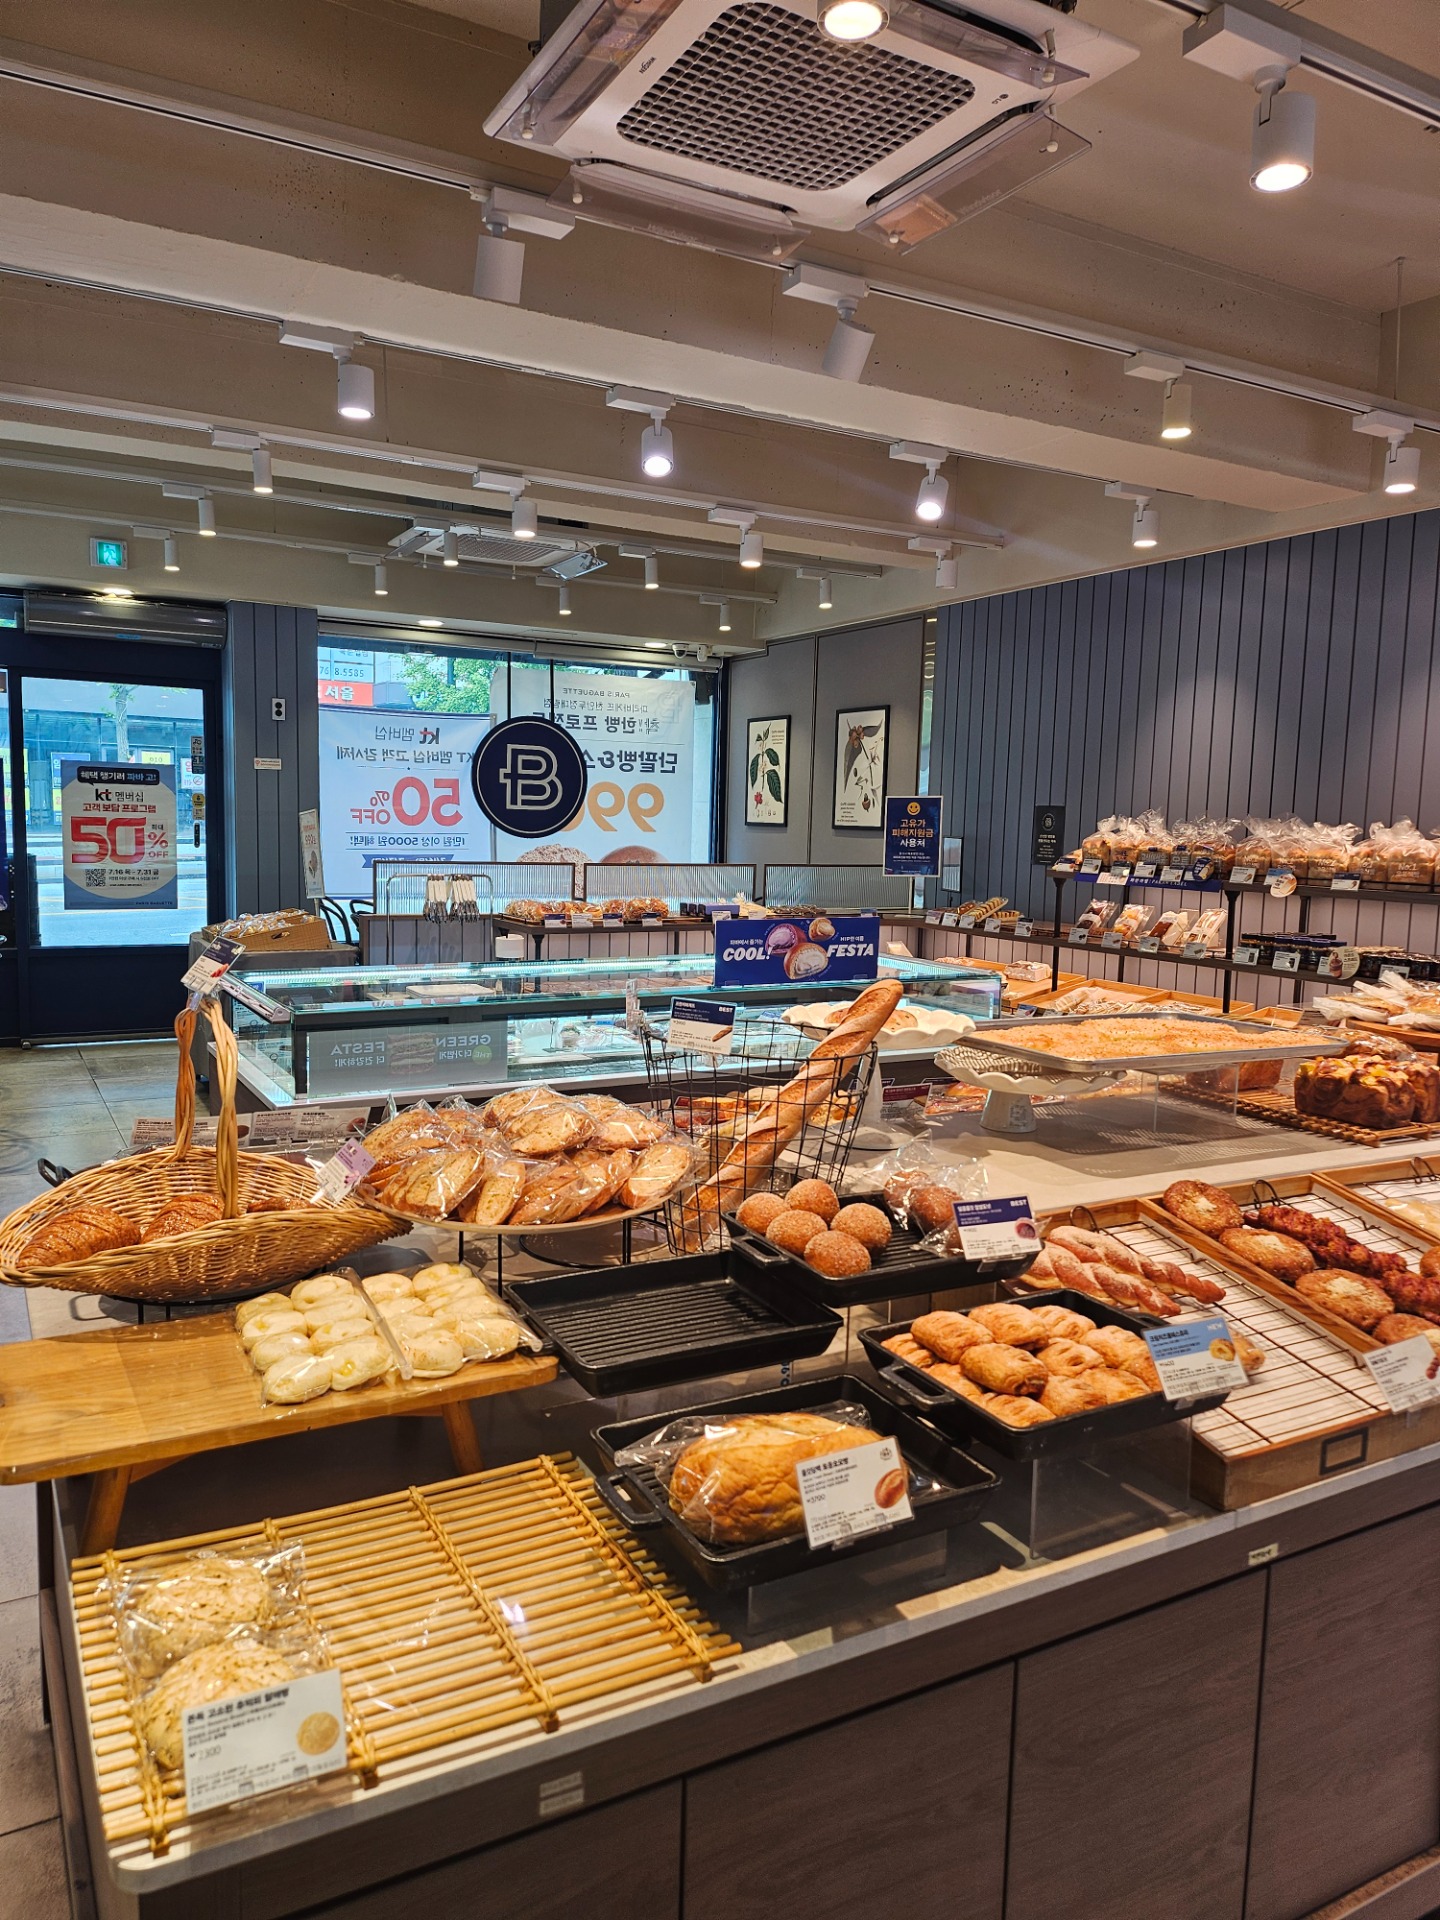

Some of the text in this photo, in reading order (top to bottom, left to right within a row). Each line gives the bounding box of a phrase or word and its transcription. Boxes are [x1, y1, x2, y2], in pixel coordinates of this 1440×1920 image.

[325, 685, 354, 701] 서울
[80, 771, 157, 781] 혜택 챙기러 파바 고!
[95, 788, 144, 802] kt 멤버십
[83, 803, 157, 813] 고객 보답 프로그램
[900, 819, 926, 828] 고유가
[892, 828, 934, 838] 피해지원금
[71, 816, 147, 865] 50
[148, 832, 169, 849] %
[900, 838, 926, 848] 사용처
[148, 850, 169, 858] OFF
[722, 946, 773, 962] COOL!
[827, 944, 874, 957] FESTA
[1010, 1199, 1027, 1207] BEST
[1207, 1323, 1222, 1331] NEW
